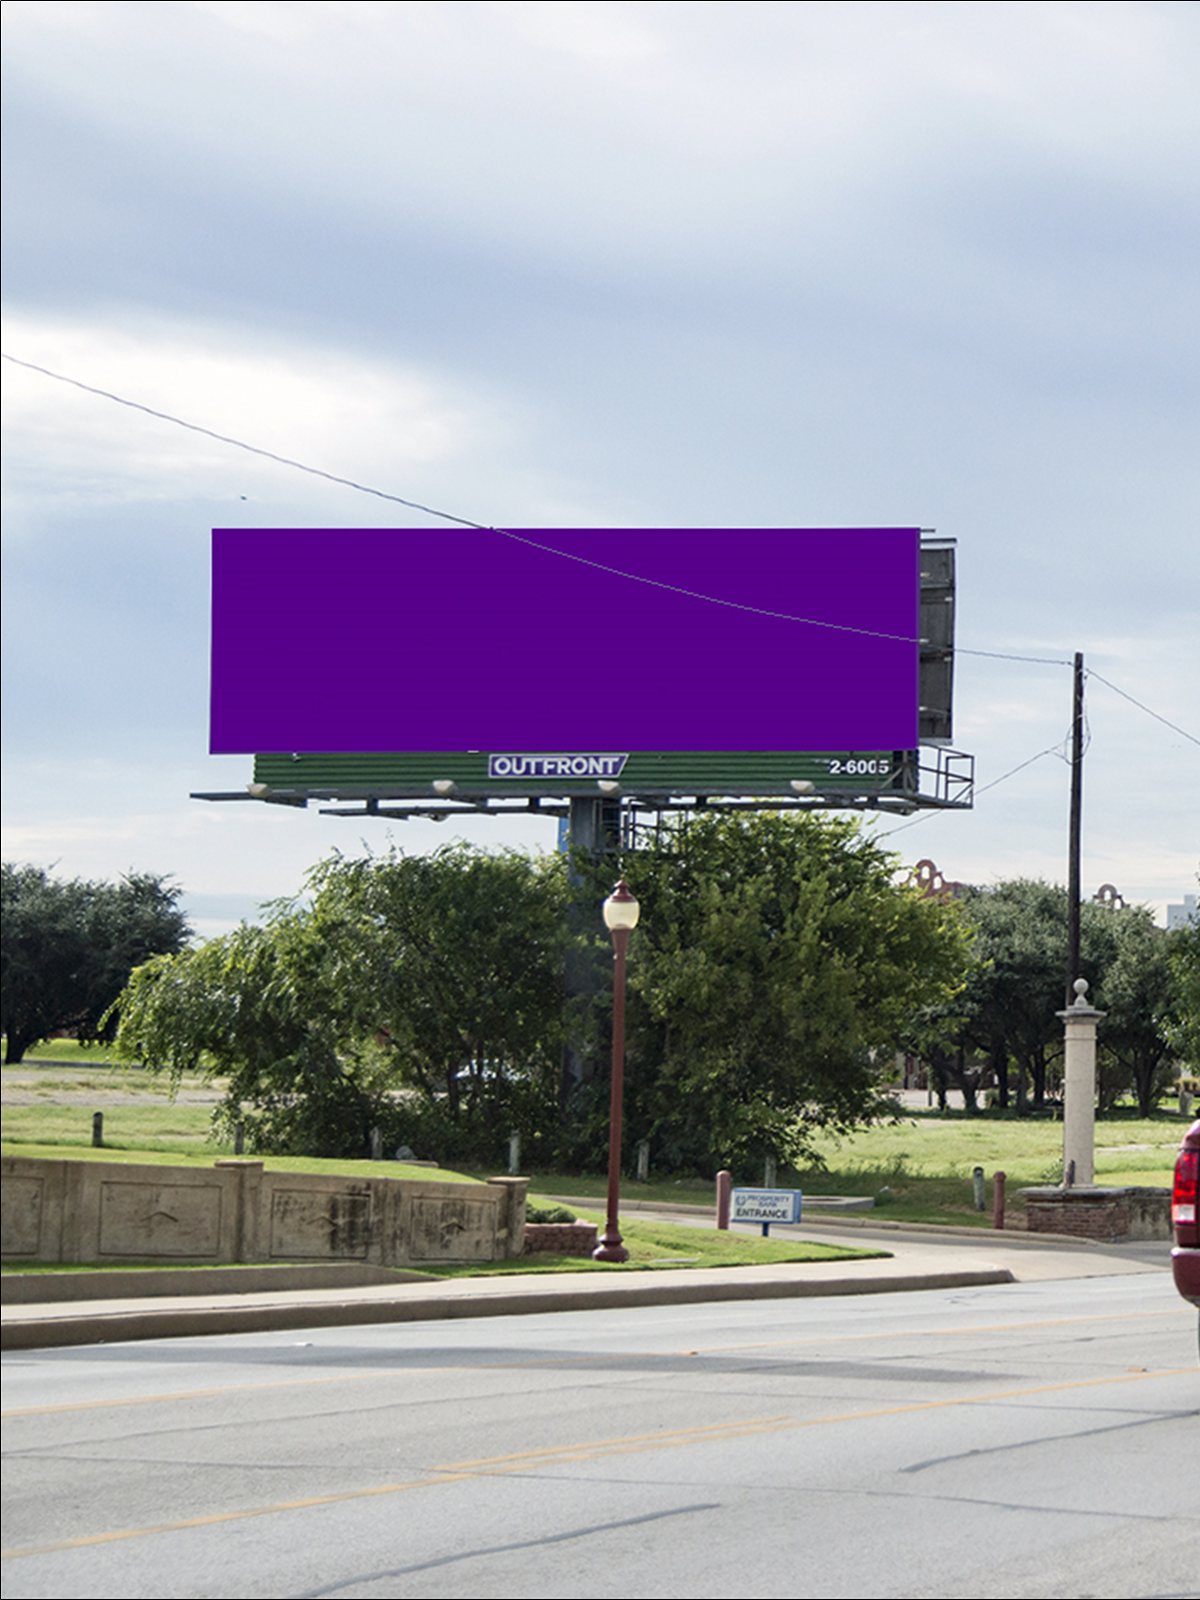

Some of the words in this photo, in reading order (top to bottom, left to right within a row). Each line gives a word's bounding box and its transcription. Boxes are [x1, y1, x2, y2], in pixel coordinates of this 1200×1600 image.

[494, 756, 620, 775] OUTFRONT
[829, 759, 890, 775] 2-6005
[747, 1194, 790, 1203] PROSPERITY
[736, 1207, 789, 1220] ENTRANCE
